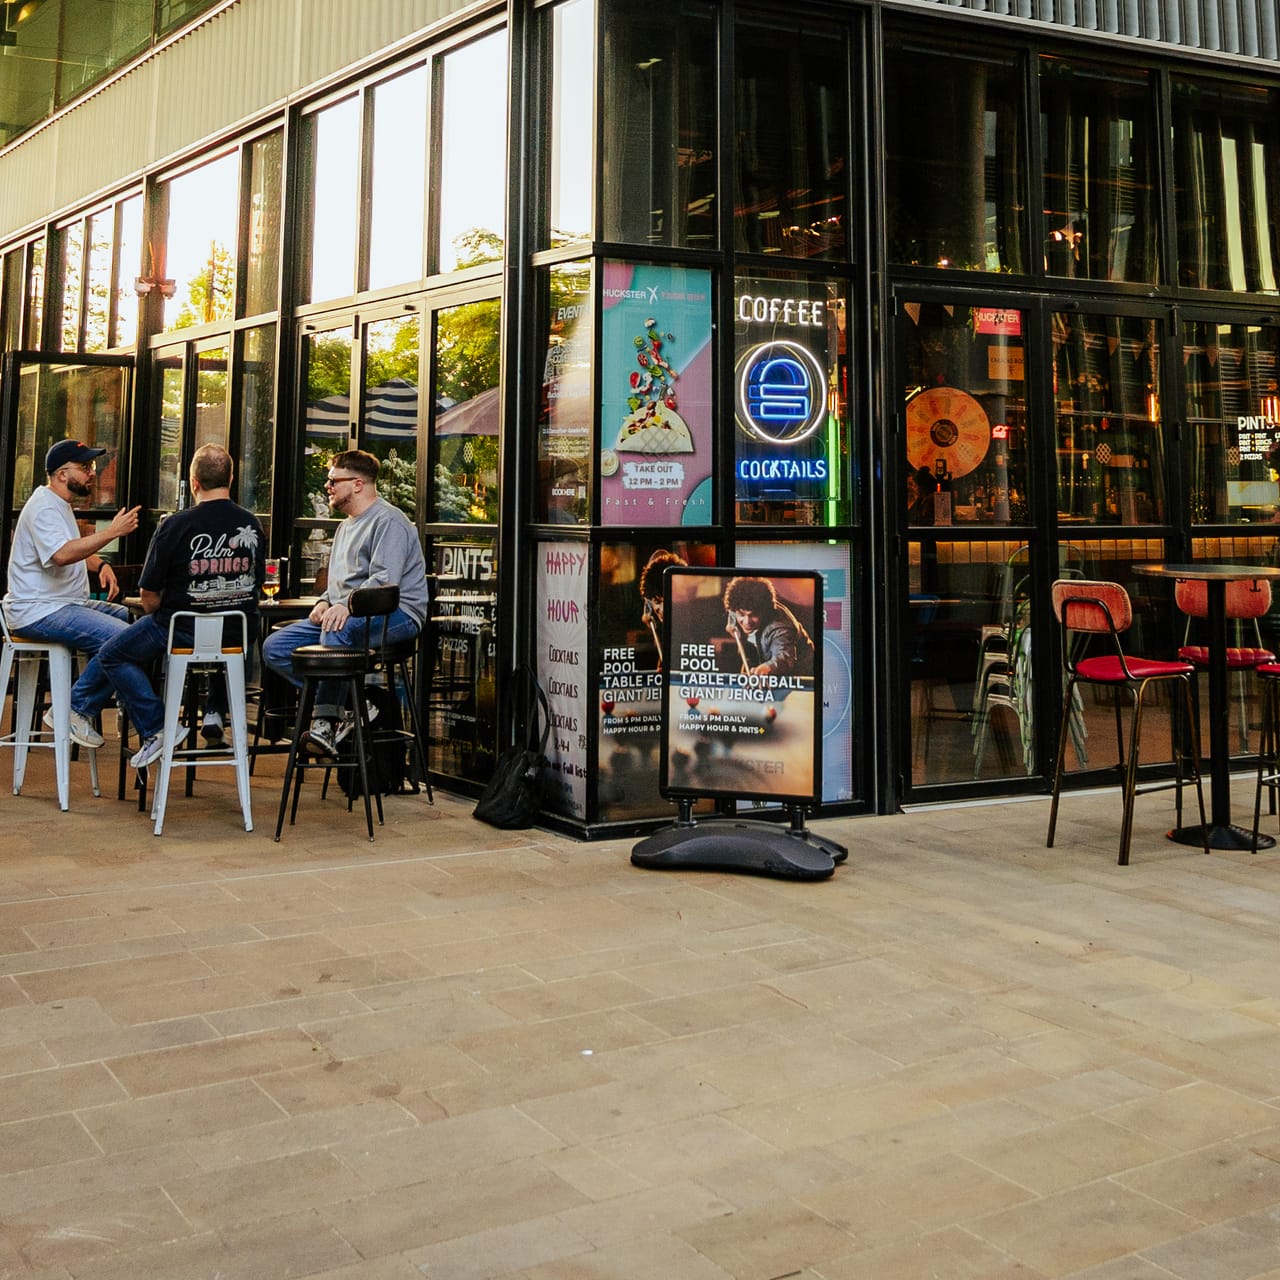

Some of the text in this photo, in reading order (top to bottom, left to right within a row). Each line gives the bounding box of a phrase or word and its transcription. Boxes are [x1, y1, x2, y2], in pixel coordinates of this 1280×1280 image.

[602, 287, 647, 300] HUCKSTER
[739, 295, 824, 326] COFFEE
[975, 311, 1020, 324] HUCKTER
[635, 465, 673, 473] TAKE OUT
[740, 459, 827, 479] COCKTAILS
[629, 478, 639, 486] 12
[640, 478, 653, 486] PM
[605, 497, 705, 506] Fast & Fresh
[190, 533, 235, 560] Palm
[189, 556, 250, 576] SPRINGS
[441, 547, 493, 581] PINTS
[546, 551, 586, 576] HAPPY
[547, 599, 579, 624] HOUR
[548, 644, 579, 666] COCKTAILS
[603, 647, 636, 661] FREE
[680, 643, 716, 657] FREE
[603, 661, 639, 675] POOL
[680, 657, 720, 672] POOL
[548, 676, 579, 699] COCKTAILS
[602, 675, 644, 689] TABLE
[680, 672, 805, 689] TABLE FOOTBALL
[603, 689, 643, 703] GIANT
[679, 686, 775, 702] GIANT JENGA
[603, 716, 623, 725] FROM
[679, 713, 702, 722] FROM
[709, 714, 722, 722] PM
[723, 715, 747, 724] DAILY
[603, 726, 627, 735] HAPPY
[628, 725, 648, 733] HOUR
[649, 724, 655, 732] &
[679, 723, 705, 732] HAPPY
[706, 724, 729, 732] HOUR
[731, 725, 737, 733] &
